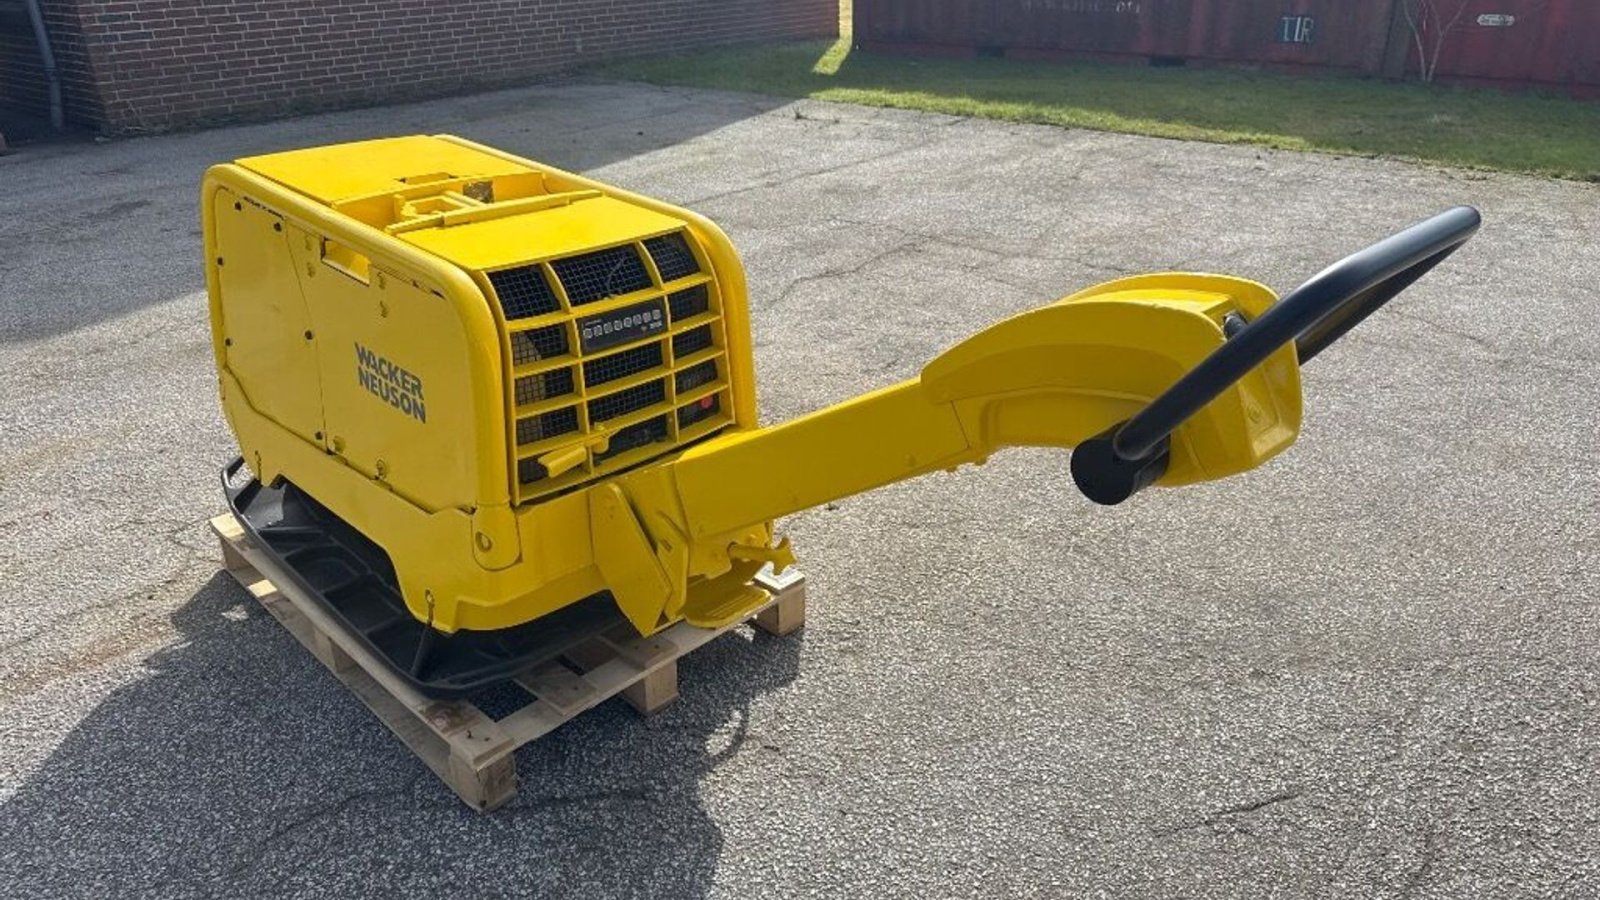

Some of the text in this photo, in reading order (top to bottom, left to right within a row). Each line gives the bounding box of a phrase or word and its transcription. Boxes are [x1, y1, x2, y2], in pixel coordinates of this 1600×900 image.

[1280, 16, 1314, 42] TIR
[354, 341, 424, 401] WACKER
[358, 365, 426, 424] NEUSON
